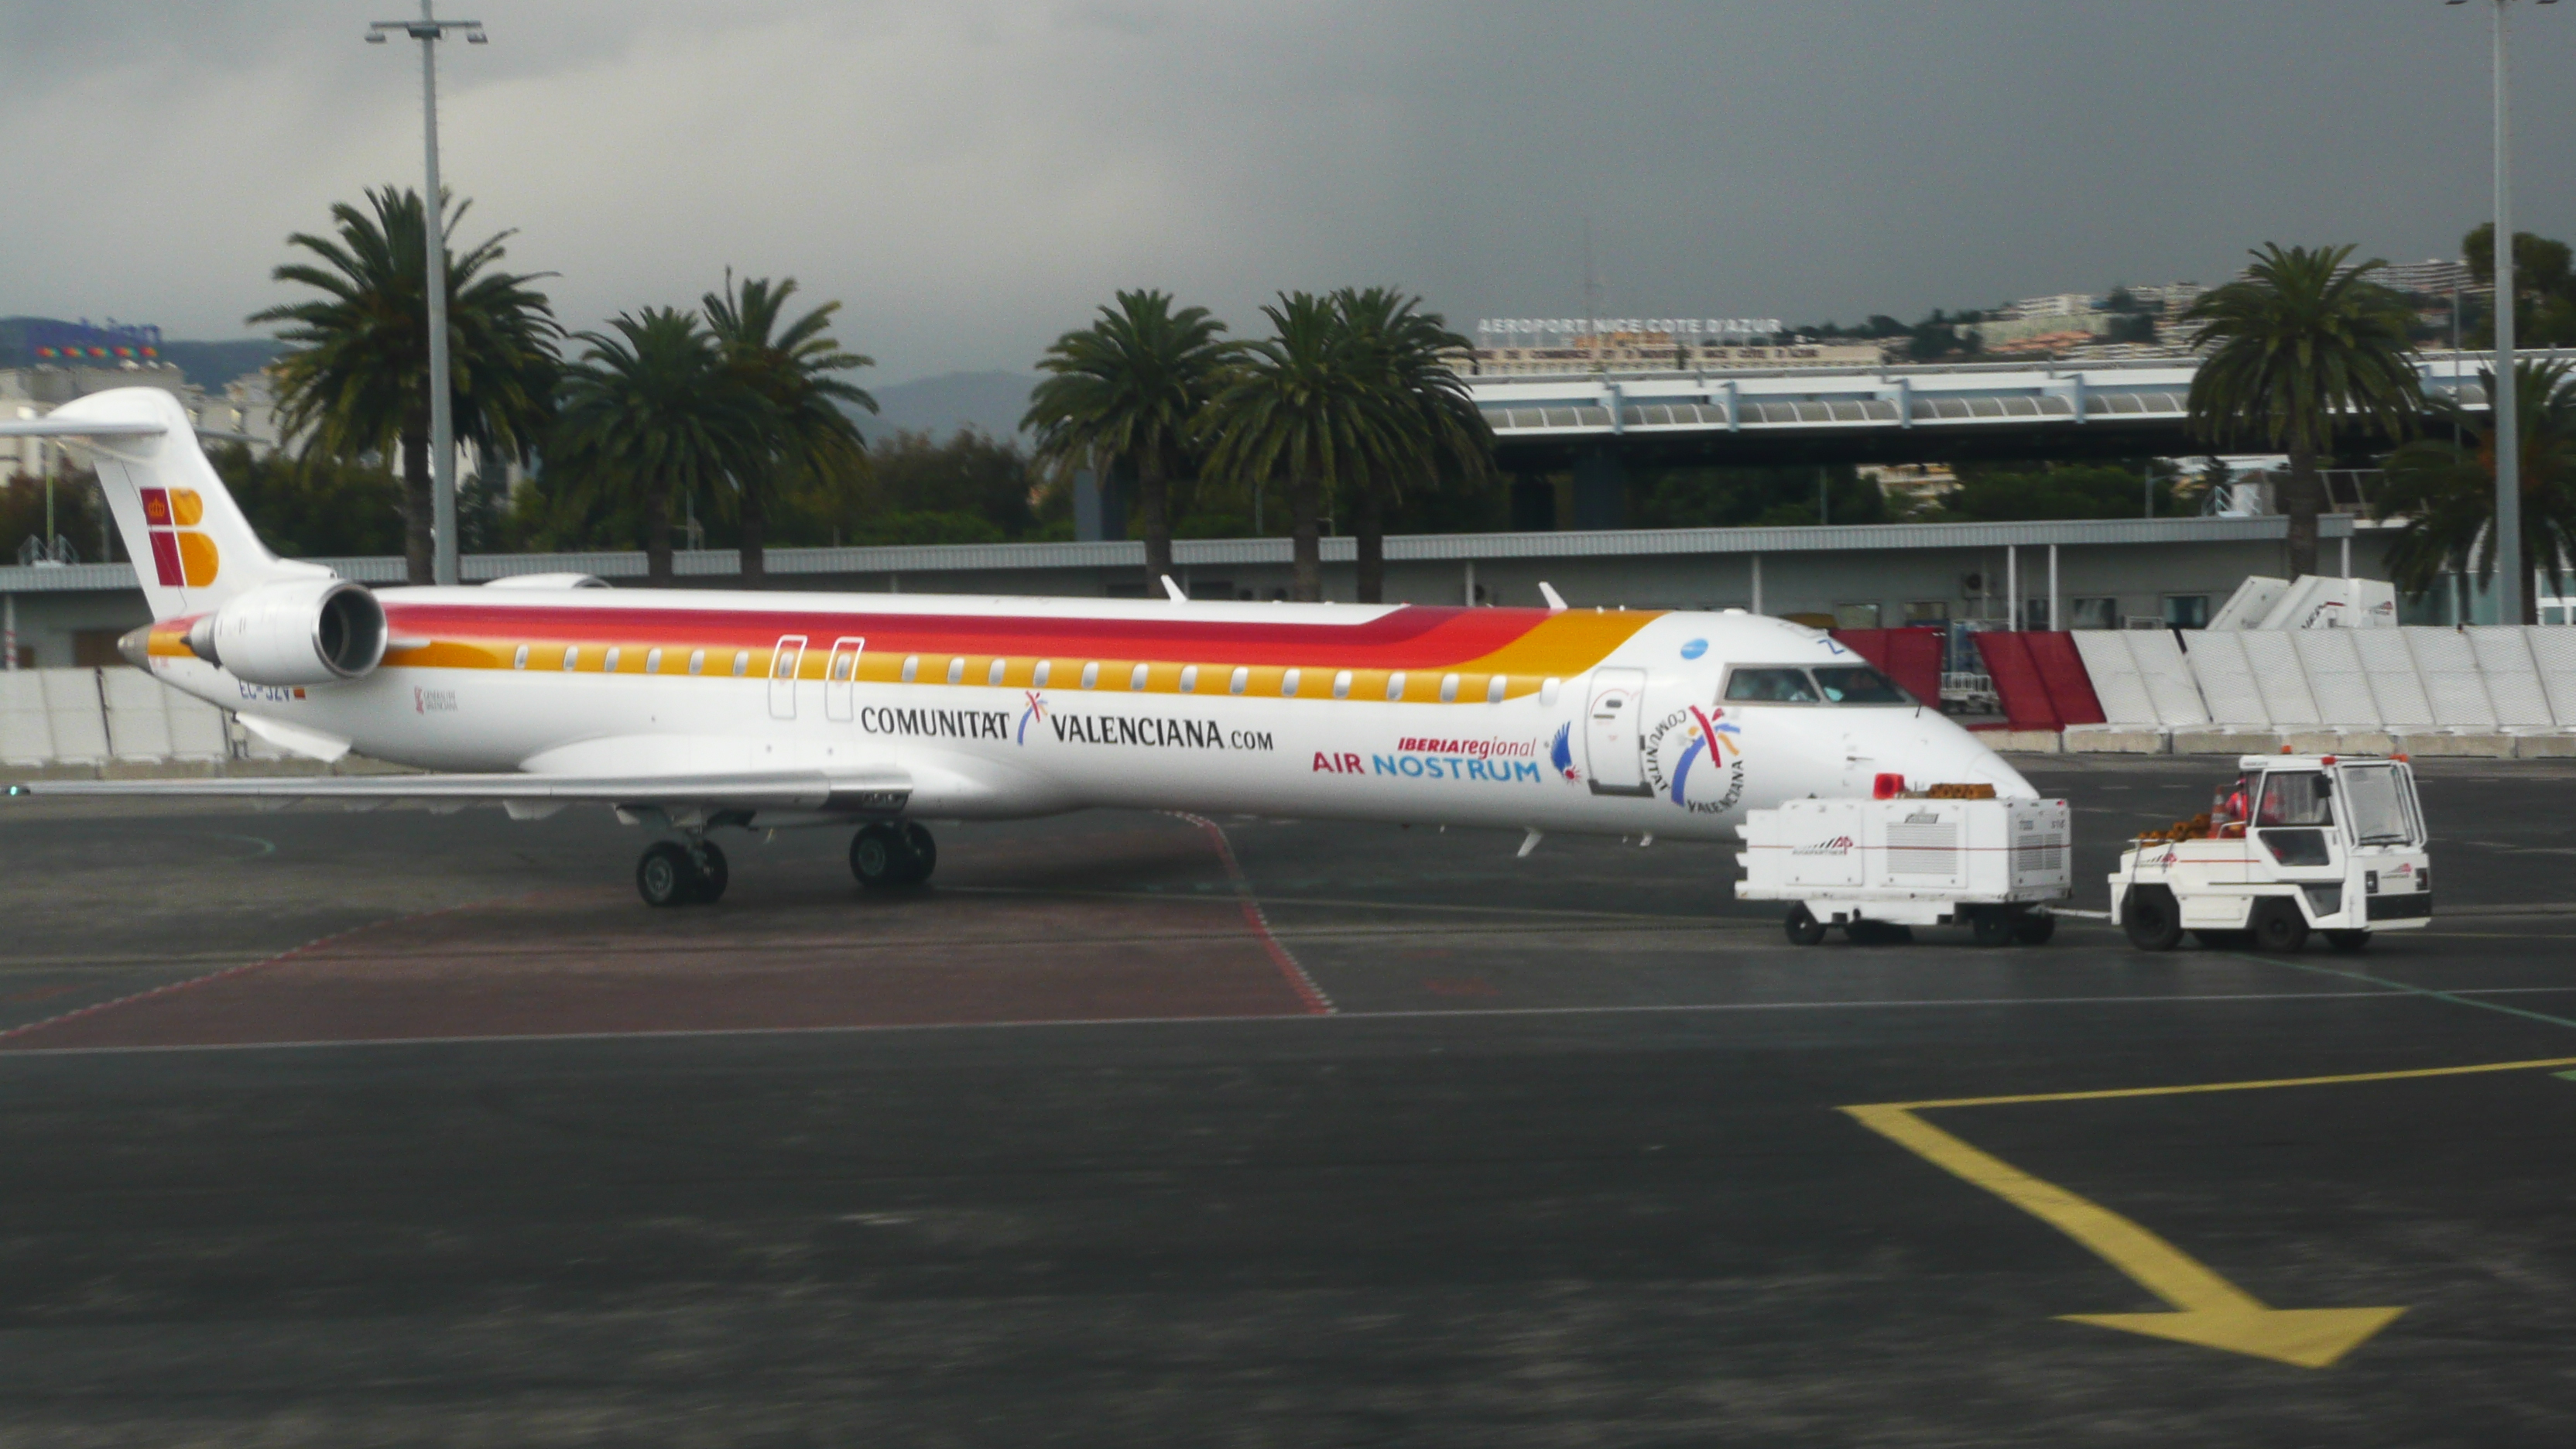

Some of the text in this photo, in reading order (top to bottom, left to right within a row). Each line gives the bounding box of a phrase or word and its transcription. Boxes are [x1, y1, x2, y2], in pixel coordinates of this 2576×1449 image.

[1477, 318, 1588, 334] AEROPORT
[1591, 318, 1642, 334] NICE
[1705, 318, 1780, 334] D'AZUR
[861, 705, 1010, 740] COMUNITAT
[1313, 751, 1541, 784] AIR NOSTRUM
[1646, 709, 1745, 814] COMUNITAT VALENCIANA
